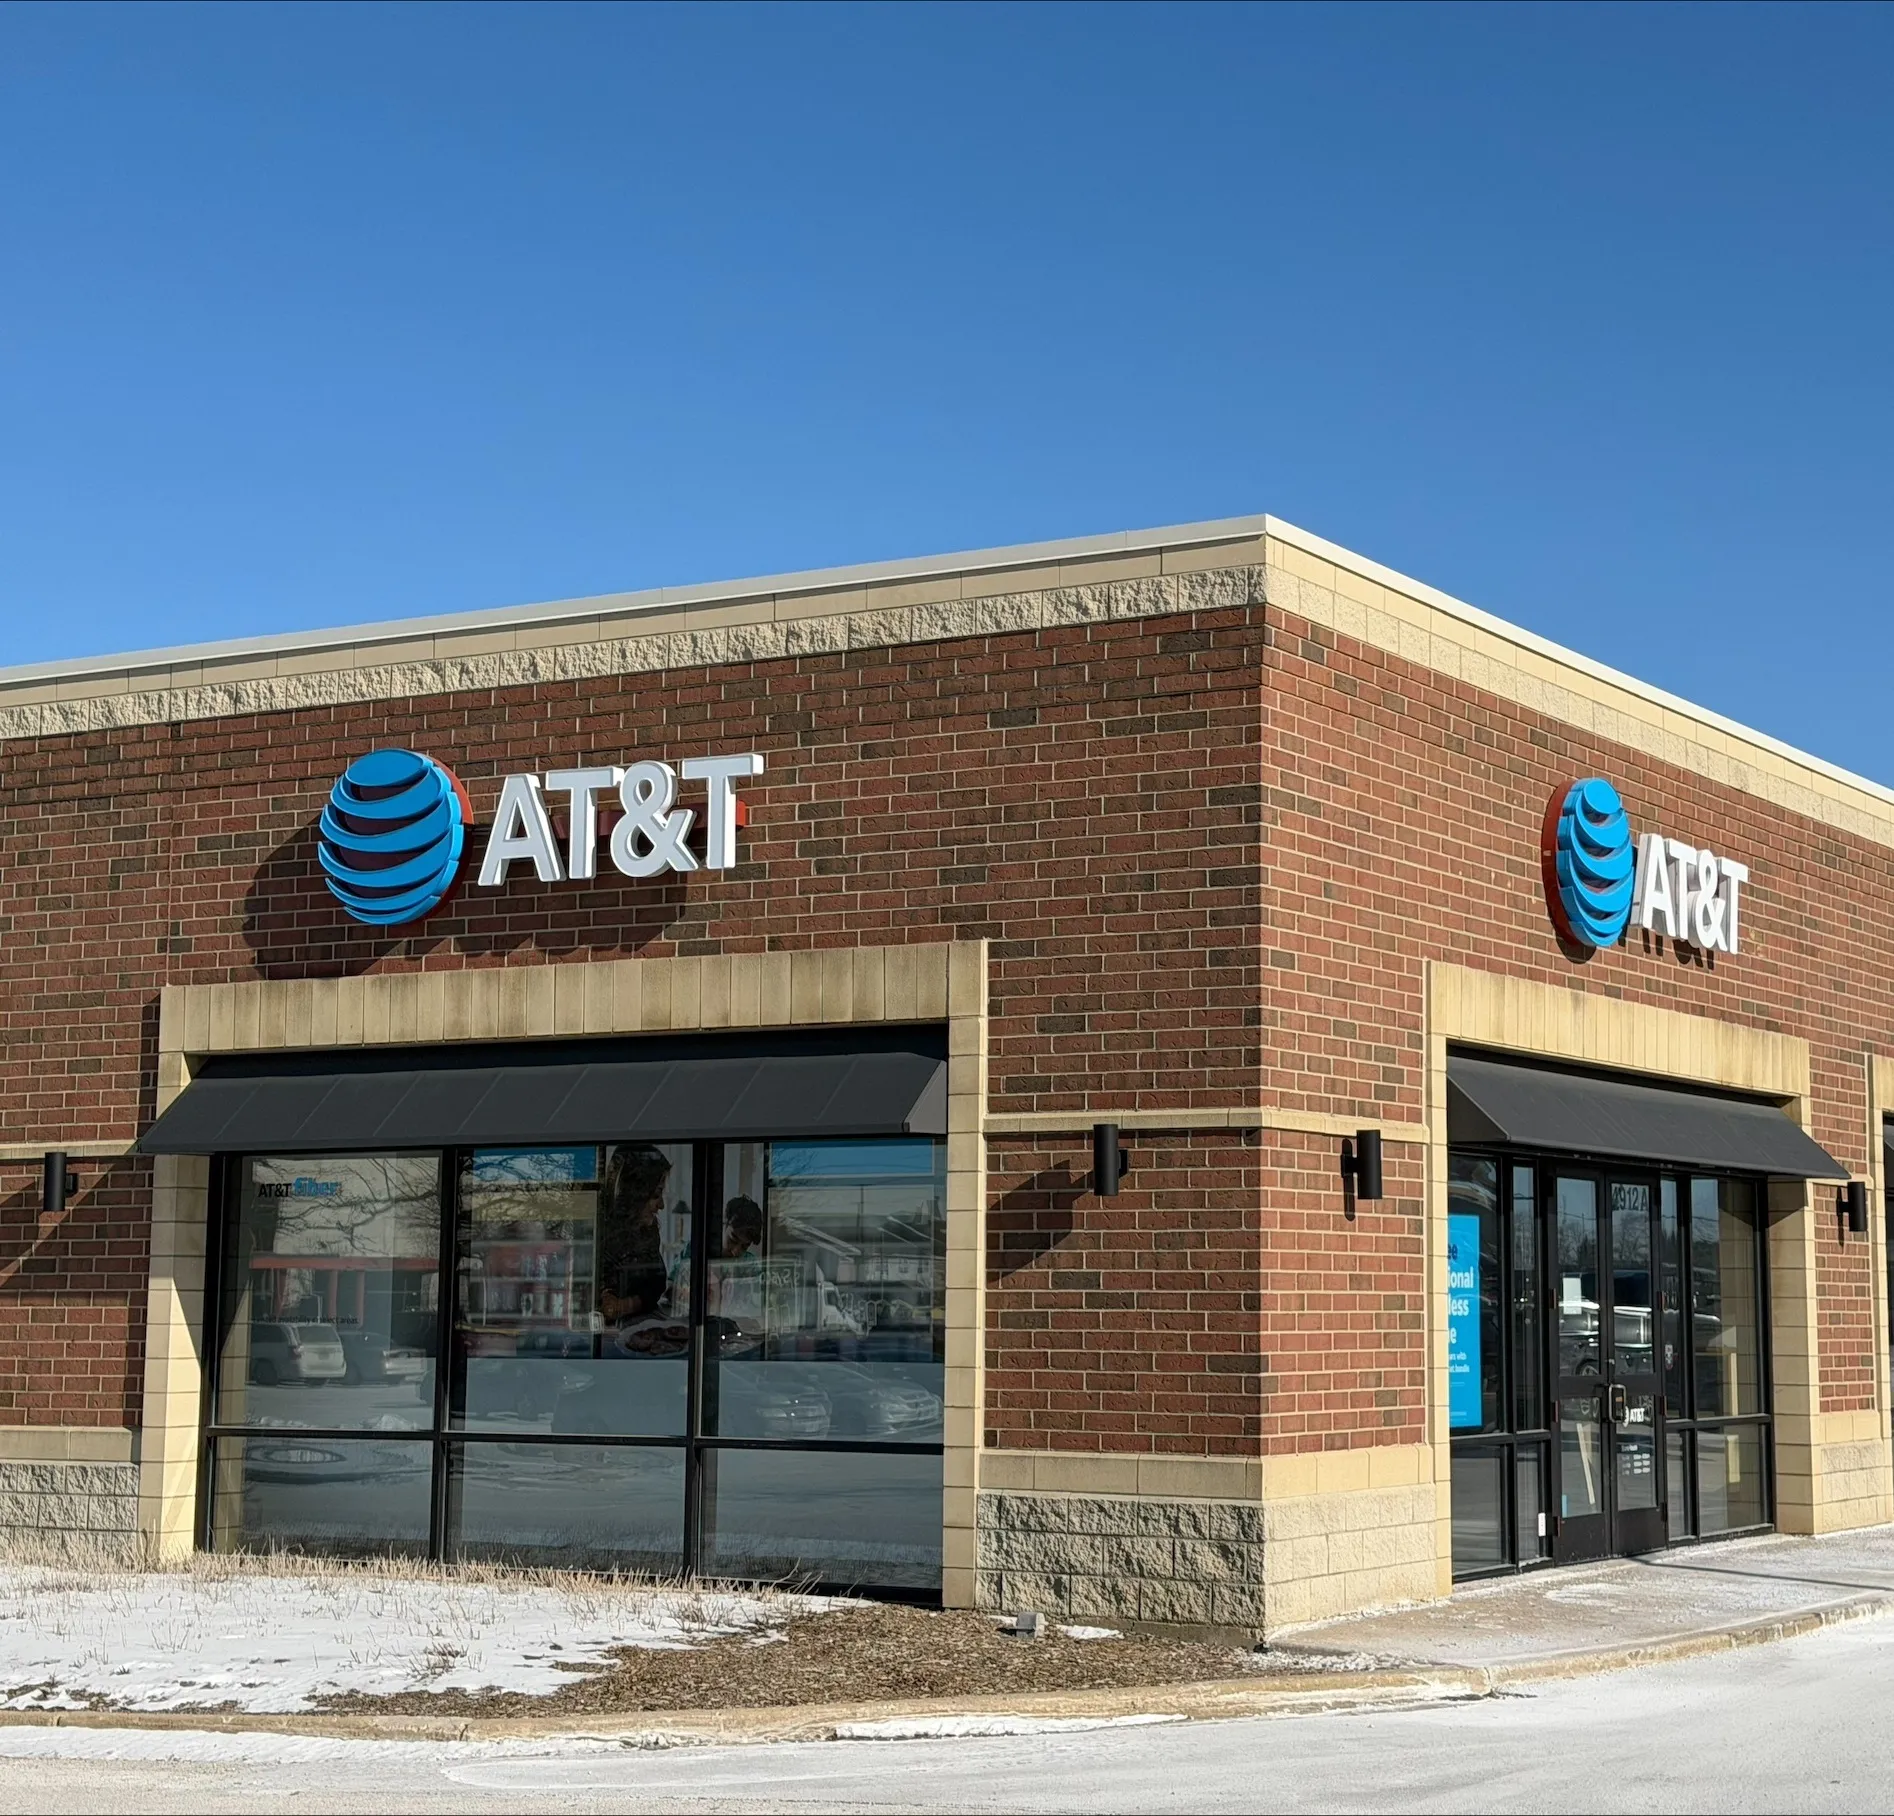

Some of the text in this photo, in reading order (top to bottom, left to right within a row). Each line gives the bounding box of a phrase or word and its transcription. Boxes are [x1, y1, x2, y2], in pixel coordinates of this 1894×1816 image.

[478, 754, 764, 887] AT&T
[1630, 833, 1749, 955] AT&T
[258, 1183, 292, 1198] AT&T
[1630, 1408, 1645, 1422] AT&T
